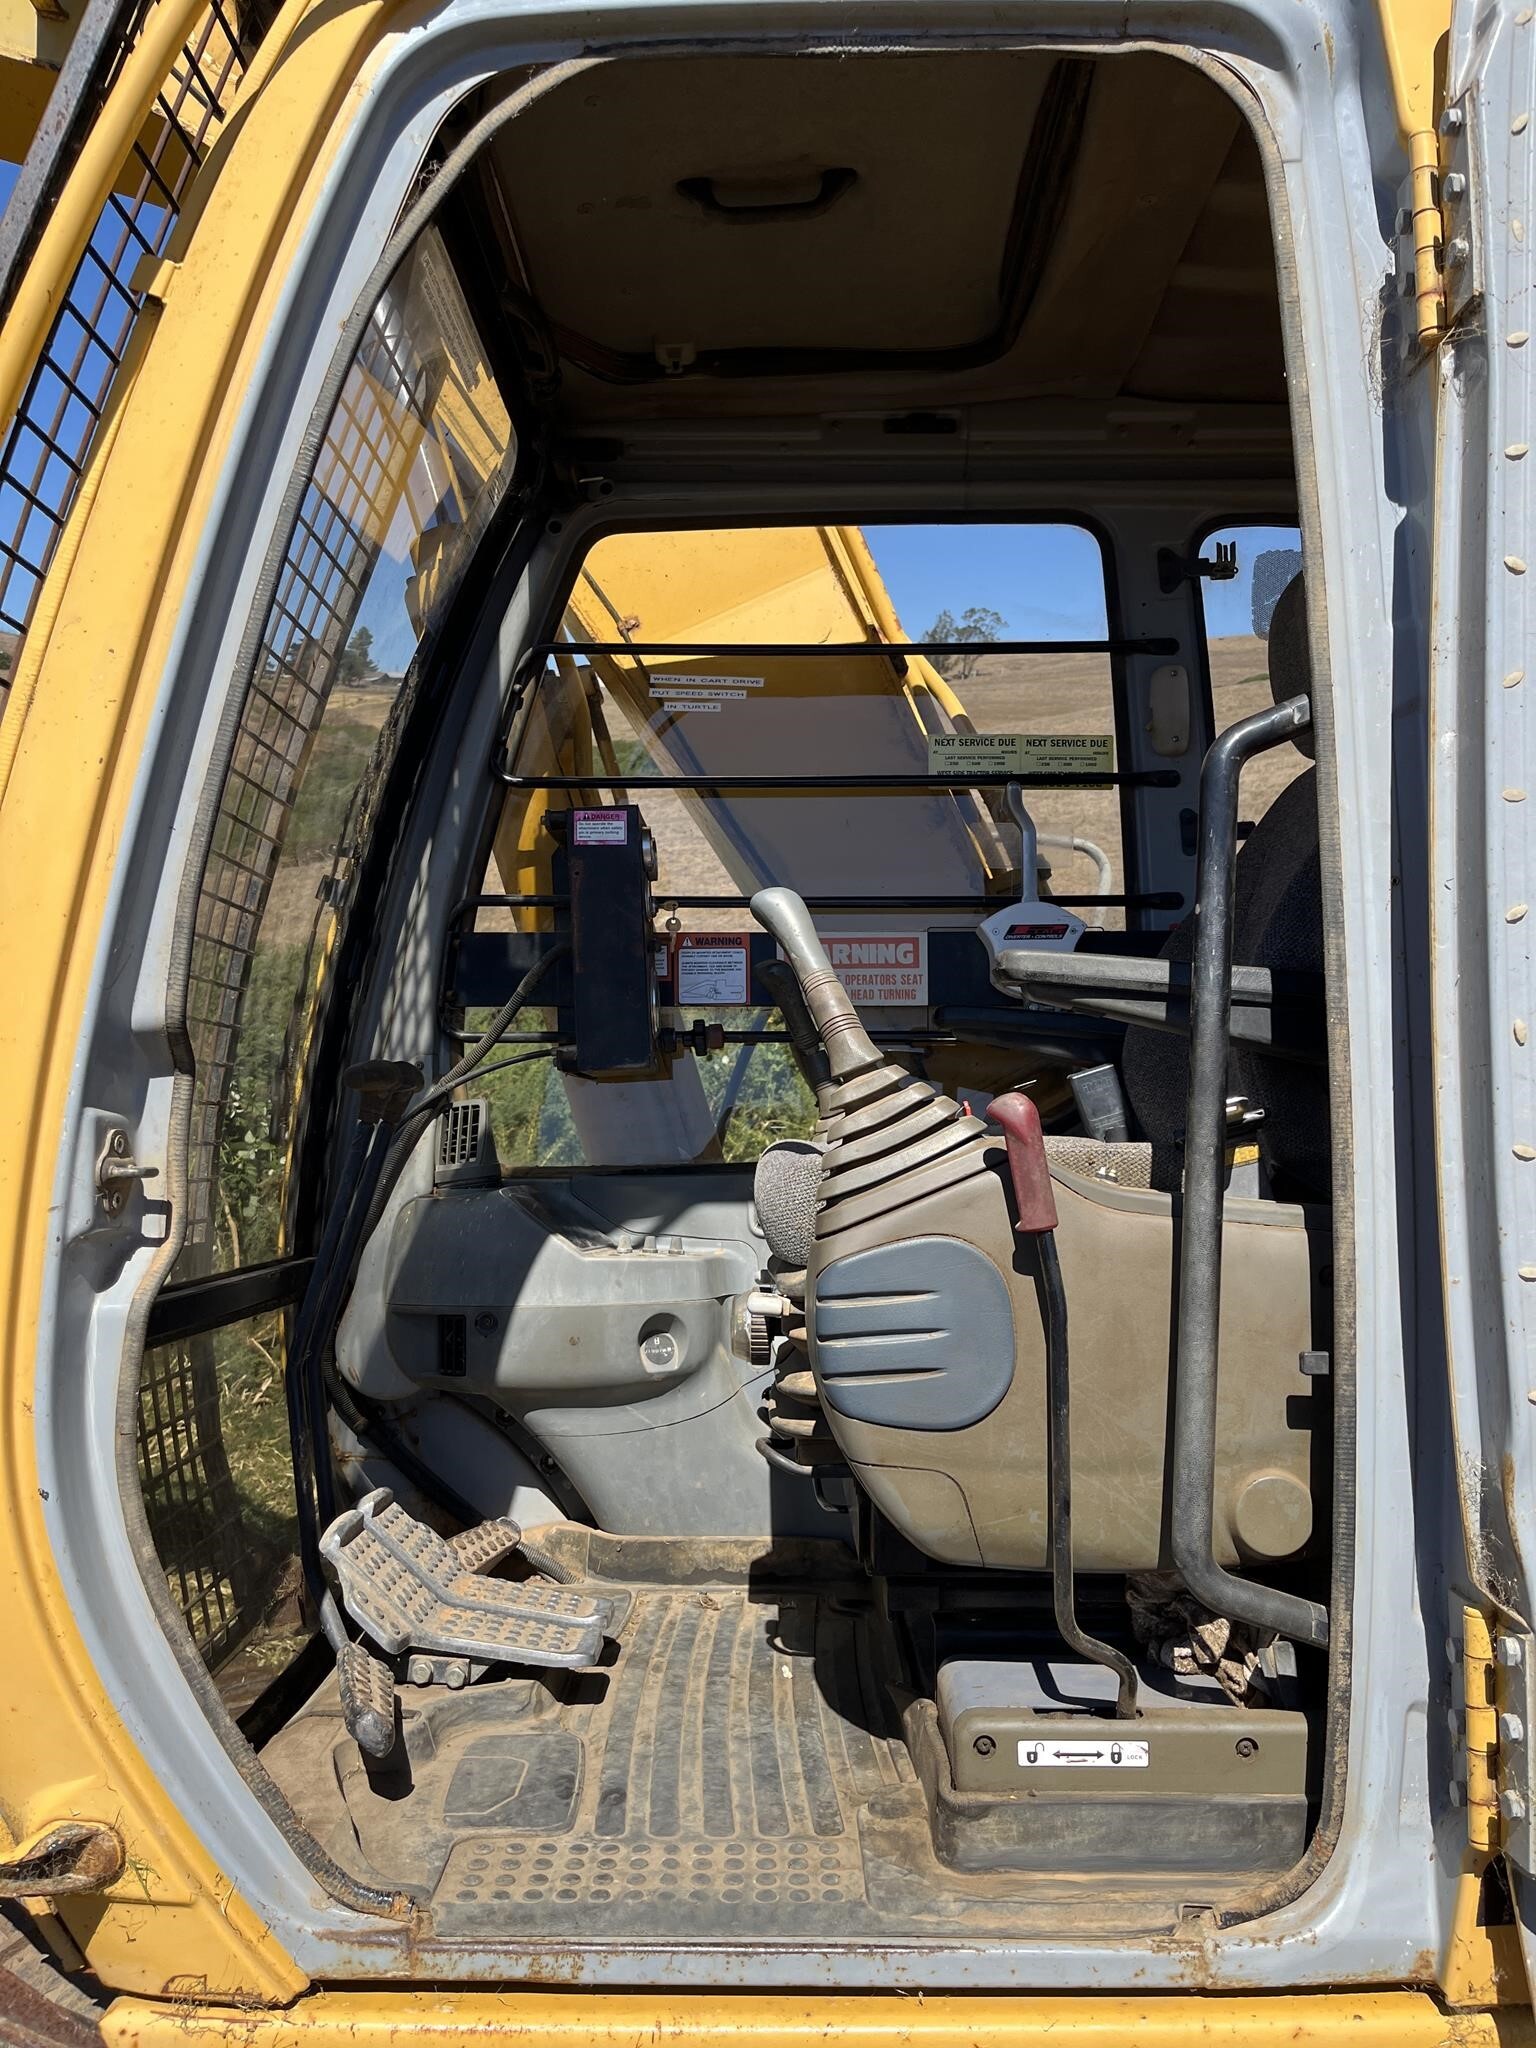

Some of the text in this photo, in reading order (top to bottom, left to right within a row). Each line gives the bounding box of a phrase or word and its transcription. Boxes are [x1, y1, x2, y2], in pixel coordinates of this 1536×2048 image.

[934, 738, 1017, 747] NEXT SERVICE DUE
[1026, 739, 1109, 748] NEXT SERVICE DUE
[695, 936, 742, 946] WARNING
[821, 943, 914, 965] RNING
[845, 974, 897, 986] OPERATORS
[900, 974, 924, 986] SEAT
[850, 988, 917, 1000] HEAD TURNING
